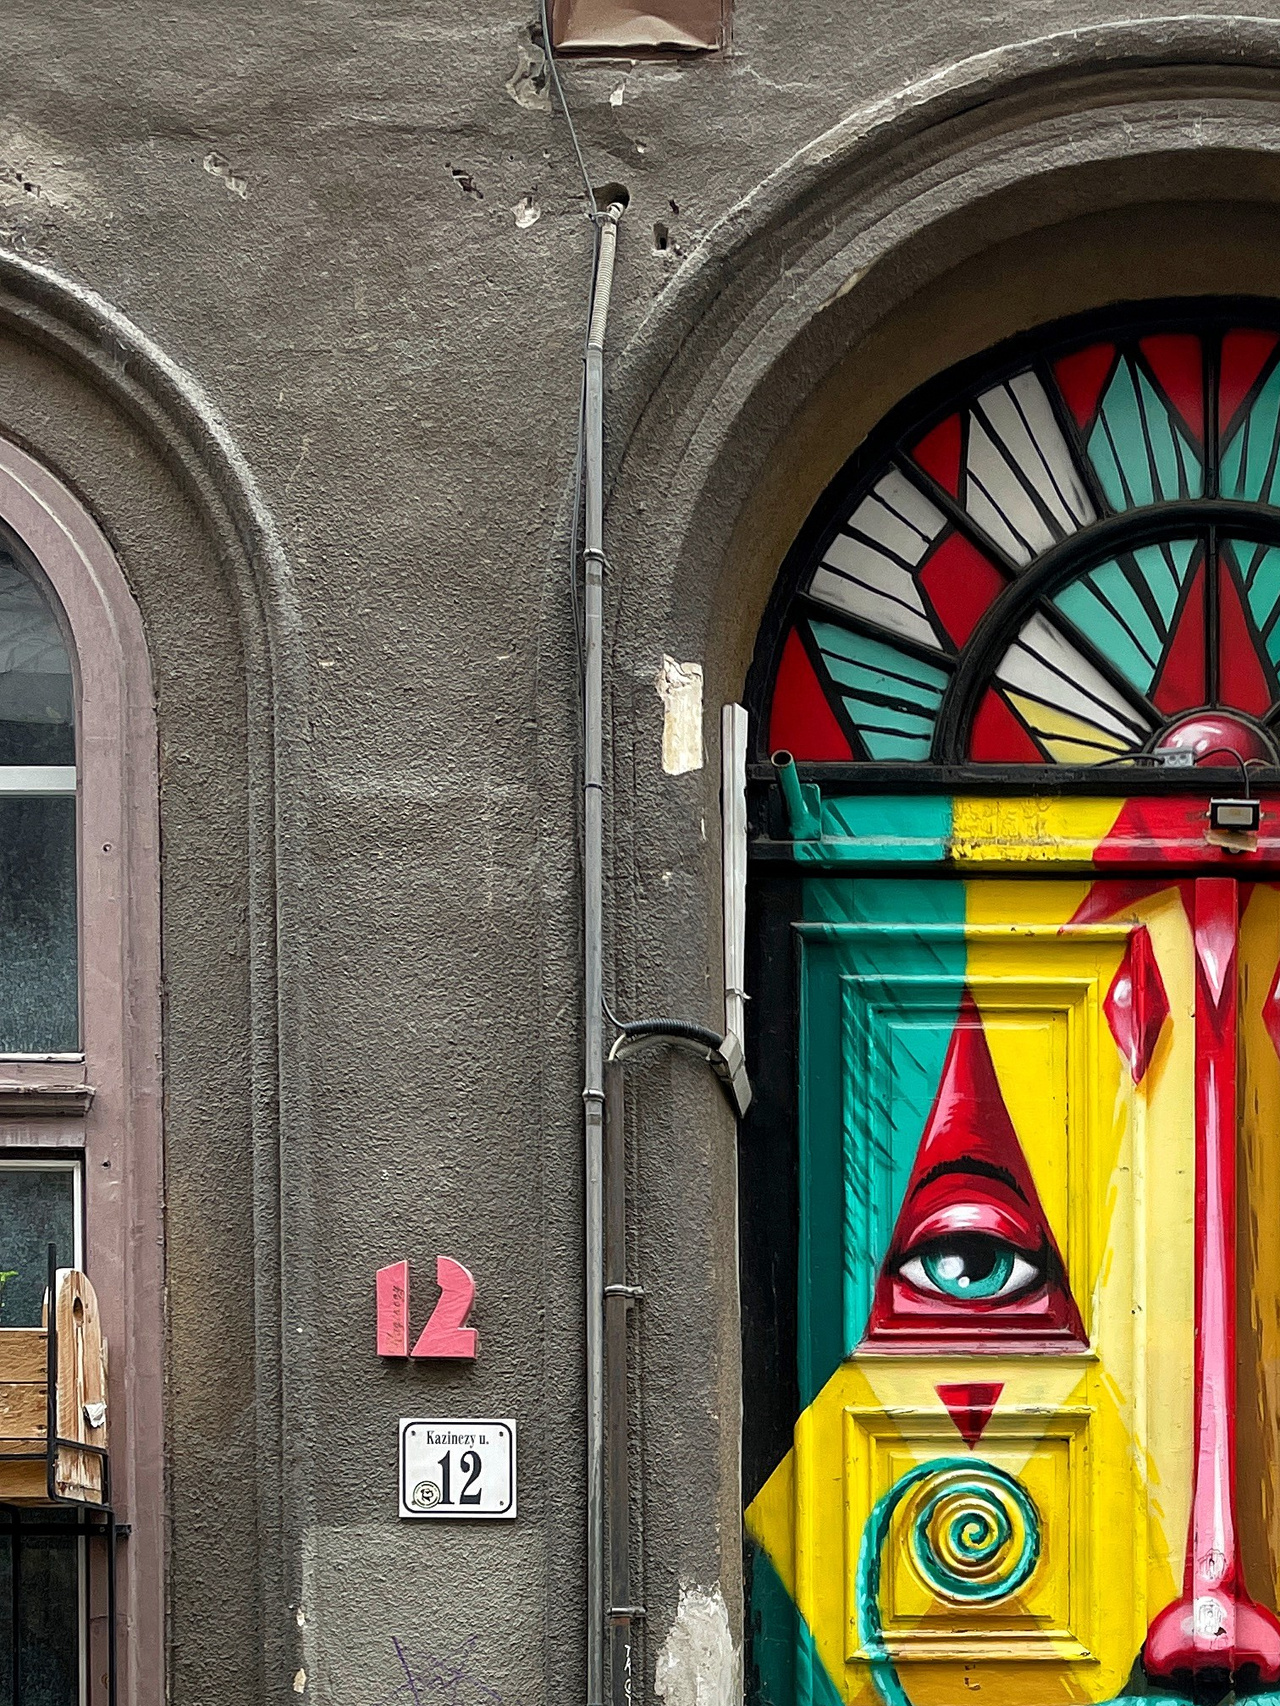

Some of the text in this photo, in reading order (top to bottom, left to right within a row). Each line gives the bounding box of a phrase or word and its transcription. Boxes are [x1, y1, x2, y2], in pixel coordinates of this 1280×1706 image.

[376, 1255, 478, 1359] 12
[426, 1430, 490, 1448] Kazinczy u.
[437, 1450, 482, 1506] 12
